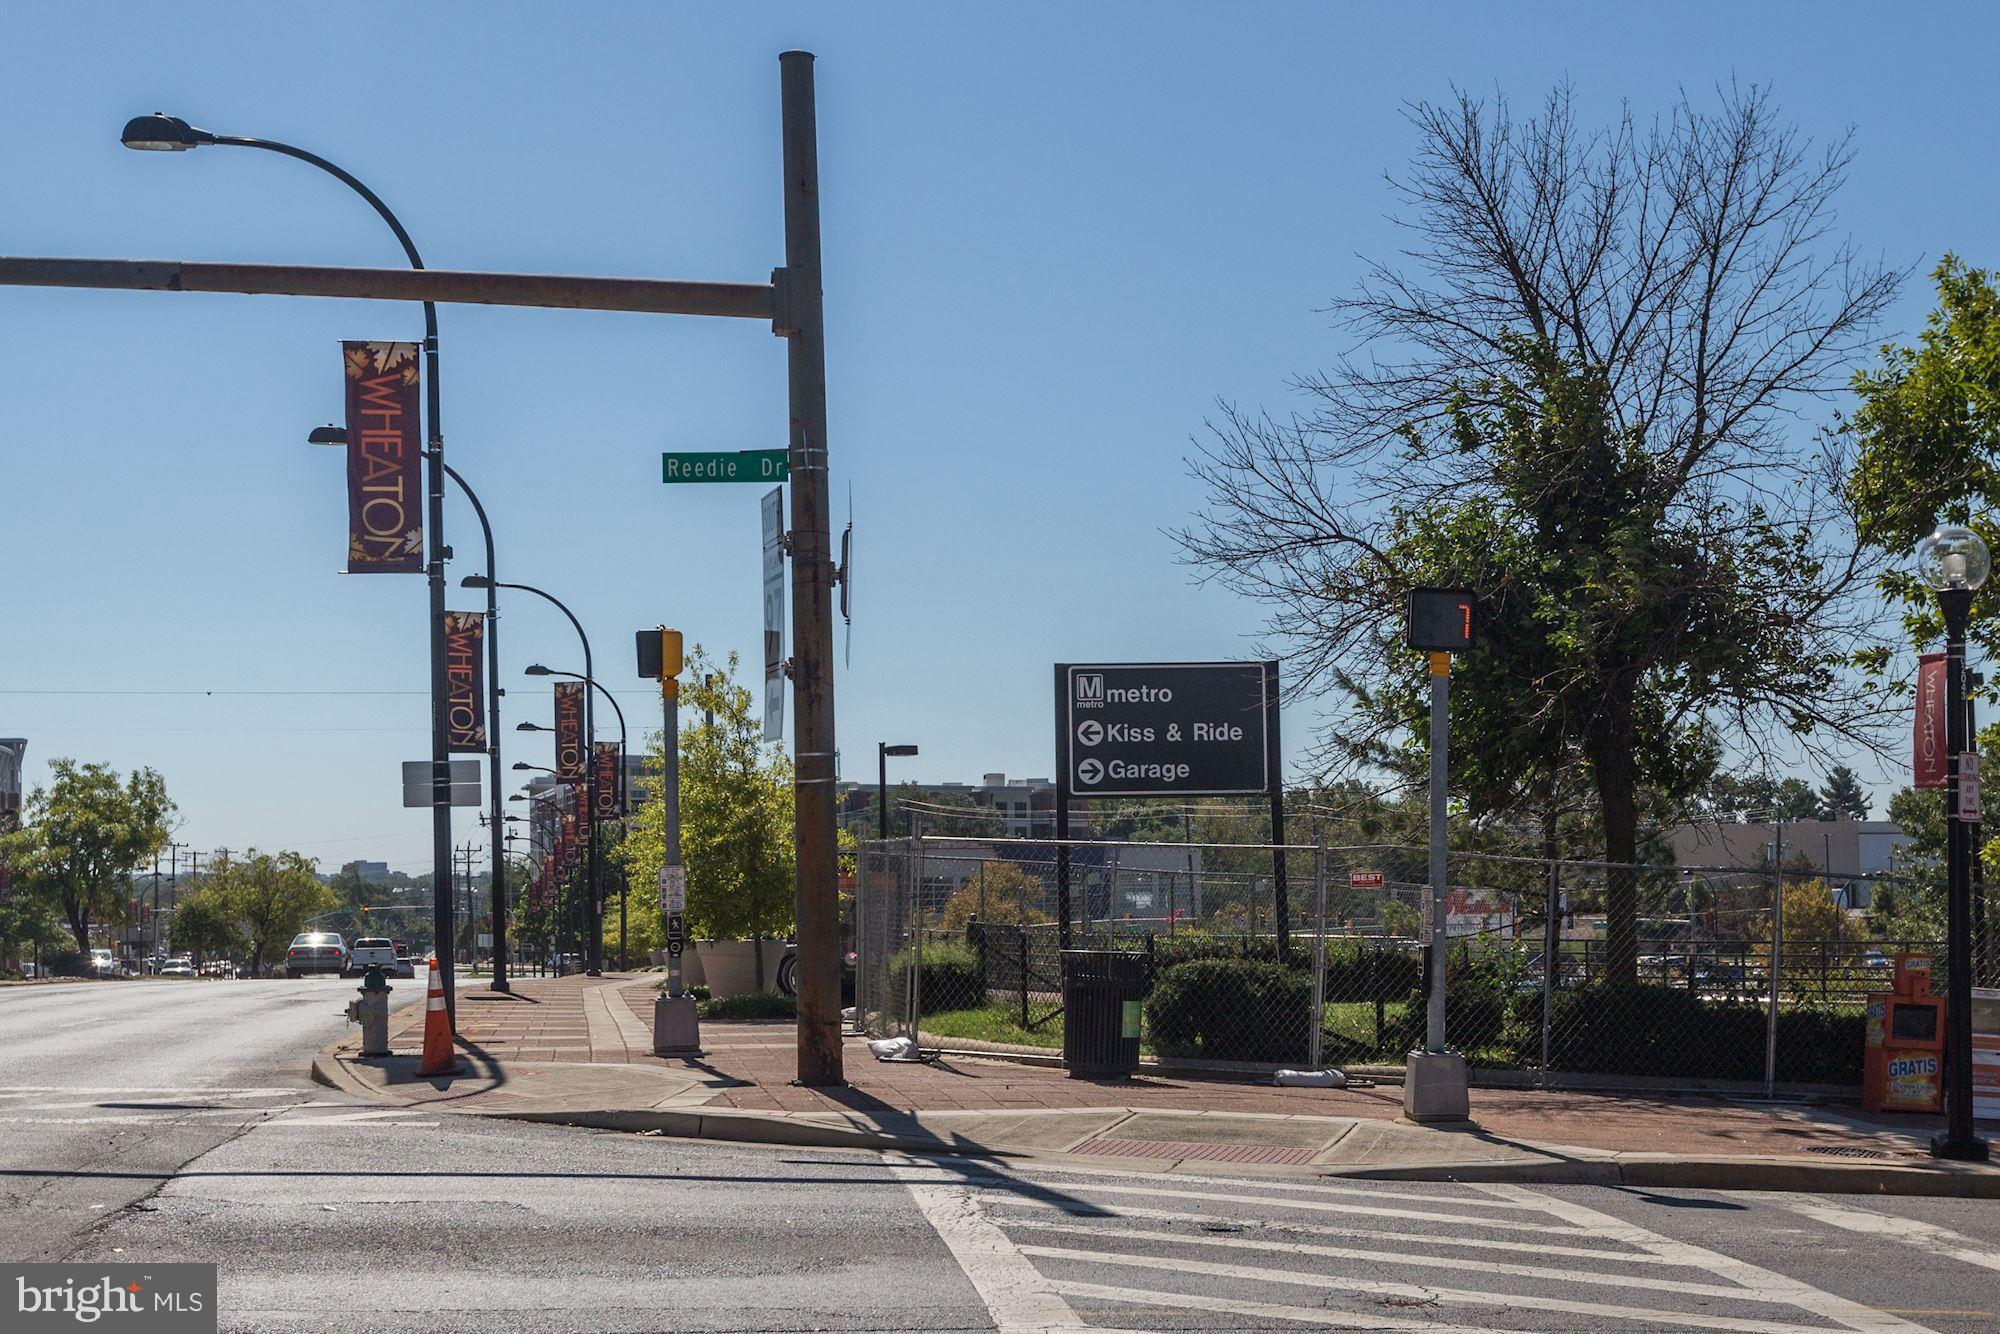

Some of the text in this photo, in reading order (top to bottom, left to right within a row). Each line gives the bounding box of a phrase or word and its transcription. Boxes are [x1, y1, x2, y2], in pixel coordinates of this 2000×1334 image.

[360, 373, 405, 562] WHEATON
[668, 458, 783, 477] Reedie Dr
[448, 631, 476, 746] WHEATON
[1079, 676, 1101, 698] M
[1106, 685, 1173, 703] metro
[1077, 700, 1104, 709] metro
[1922, 670, 1938, 773] WHEATON
[560, 696, 579, 779] WHEATON
[1107, 722, 1244, 742] Kiss & Ride
[1108, 760, 1191, 783] Garage
[1965, 757, 1974, 771] NO
[599, 753, 614, 818] WHEATON
[1353, 873, 1382, 882] BEST
[1905, 960, 1931, 969] GRATIS
[1889, 1058, 1937, 1077] GRATIS
